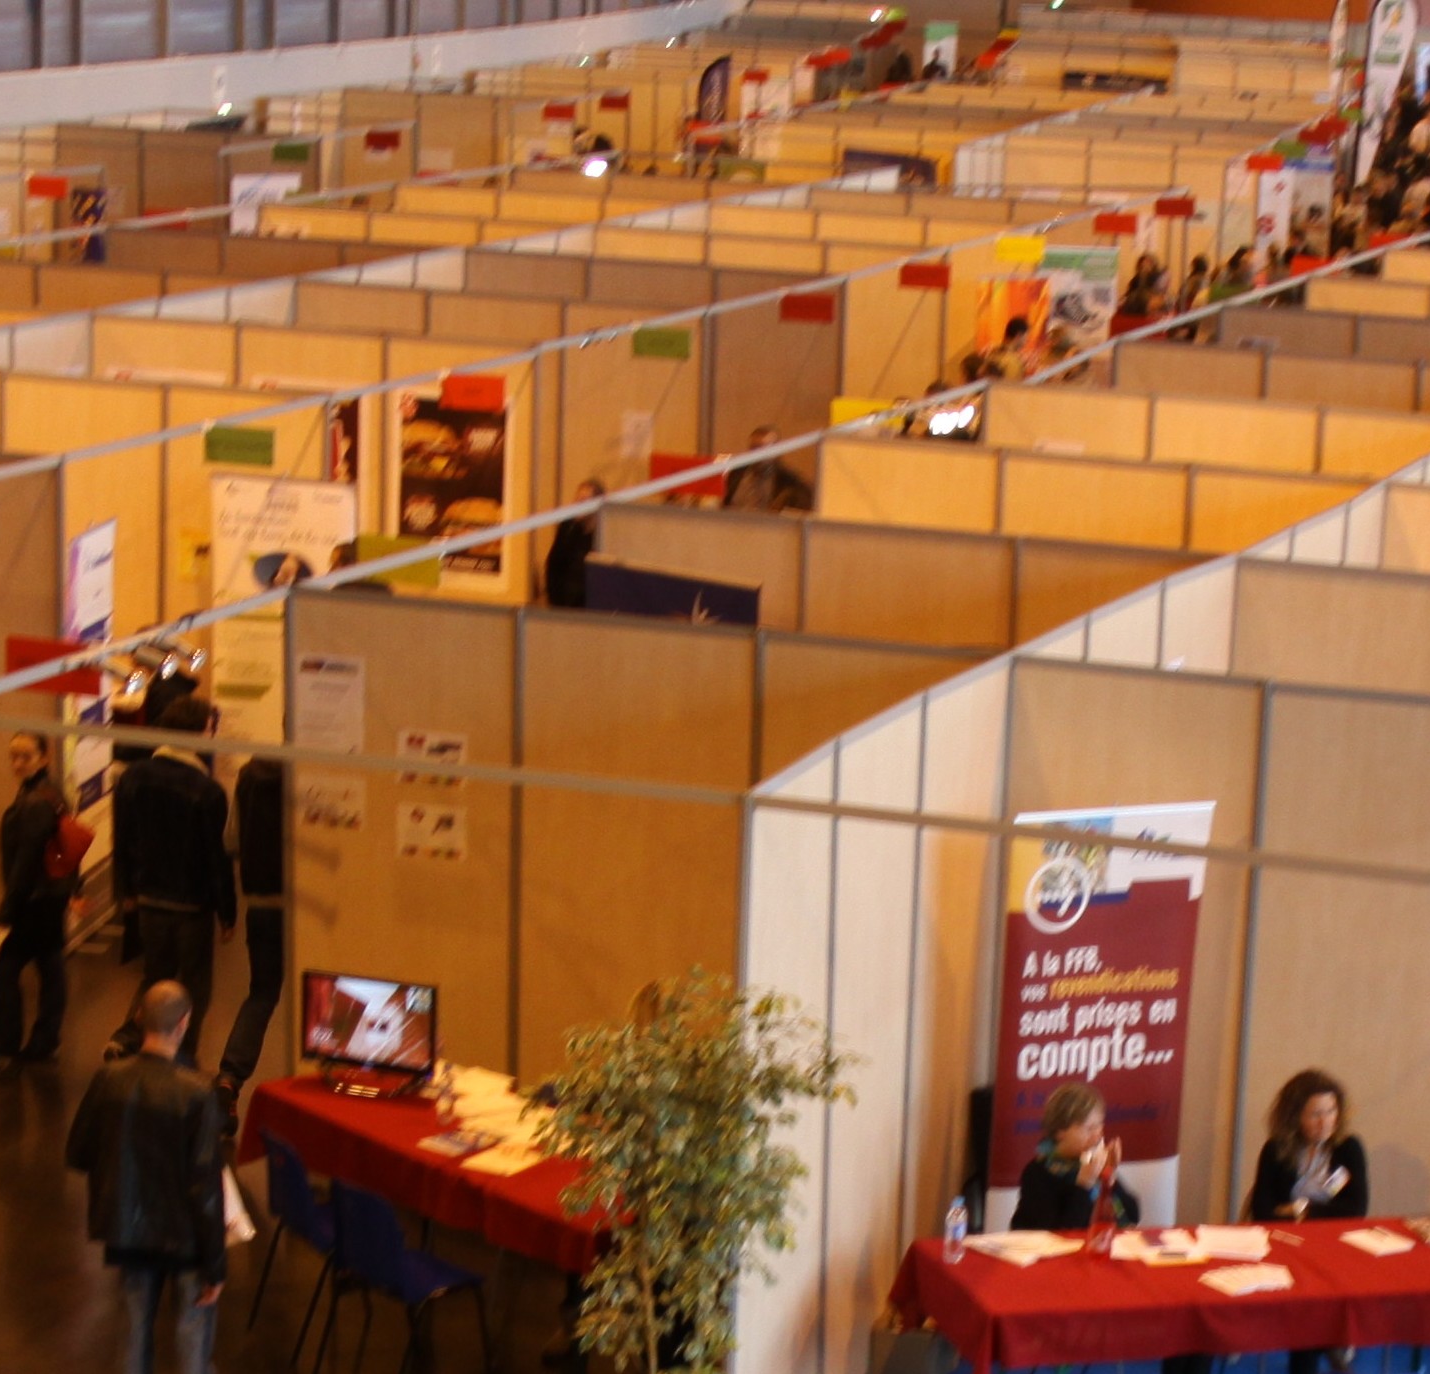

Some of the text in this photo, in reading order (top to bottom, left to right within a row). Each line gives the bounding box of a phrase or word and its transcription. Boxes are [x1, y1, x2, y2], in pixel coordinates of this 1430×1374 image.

[1022, 944, 1103, 979] A la FFB,
[1049, 966, 1179, 1001] revendications
[1018, 997, 1177, 1037] sont prises en
[1016, 1024, 1175, 1082] compte...
